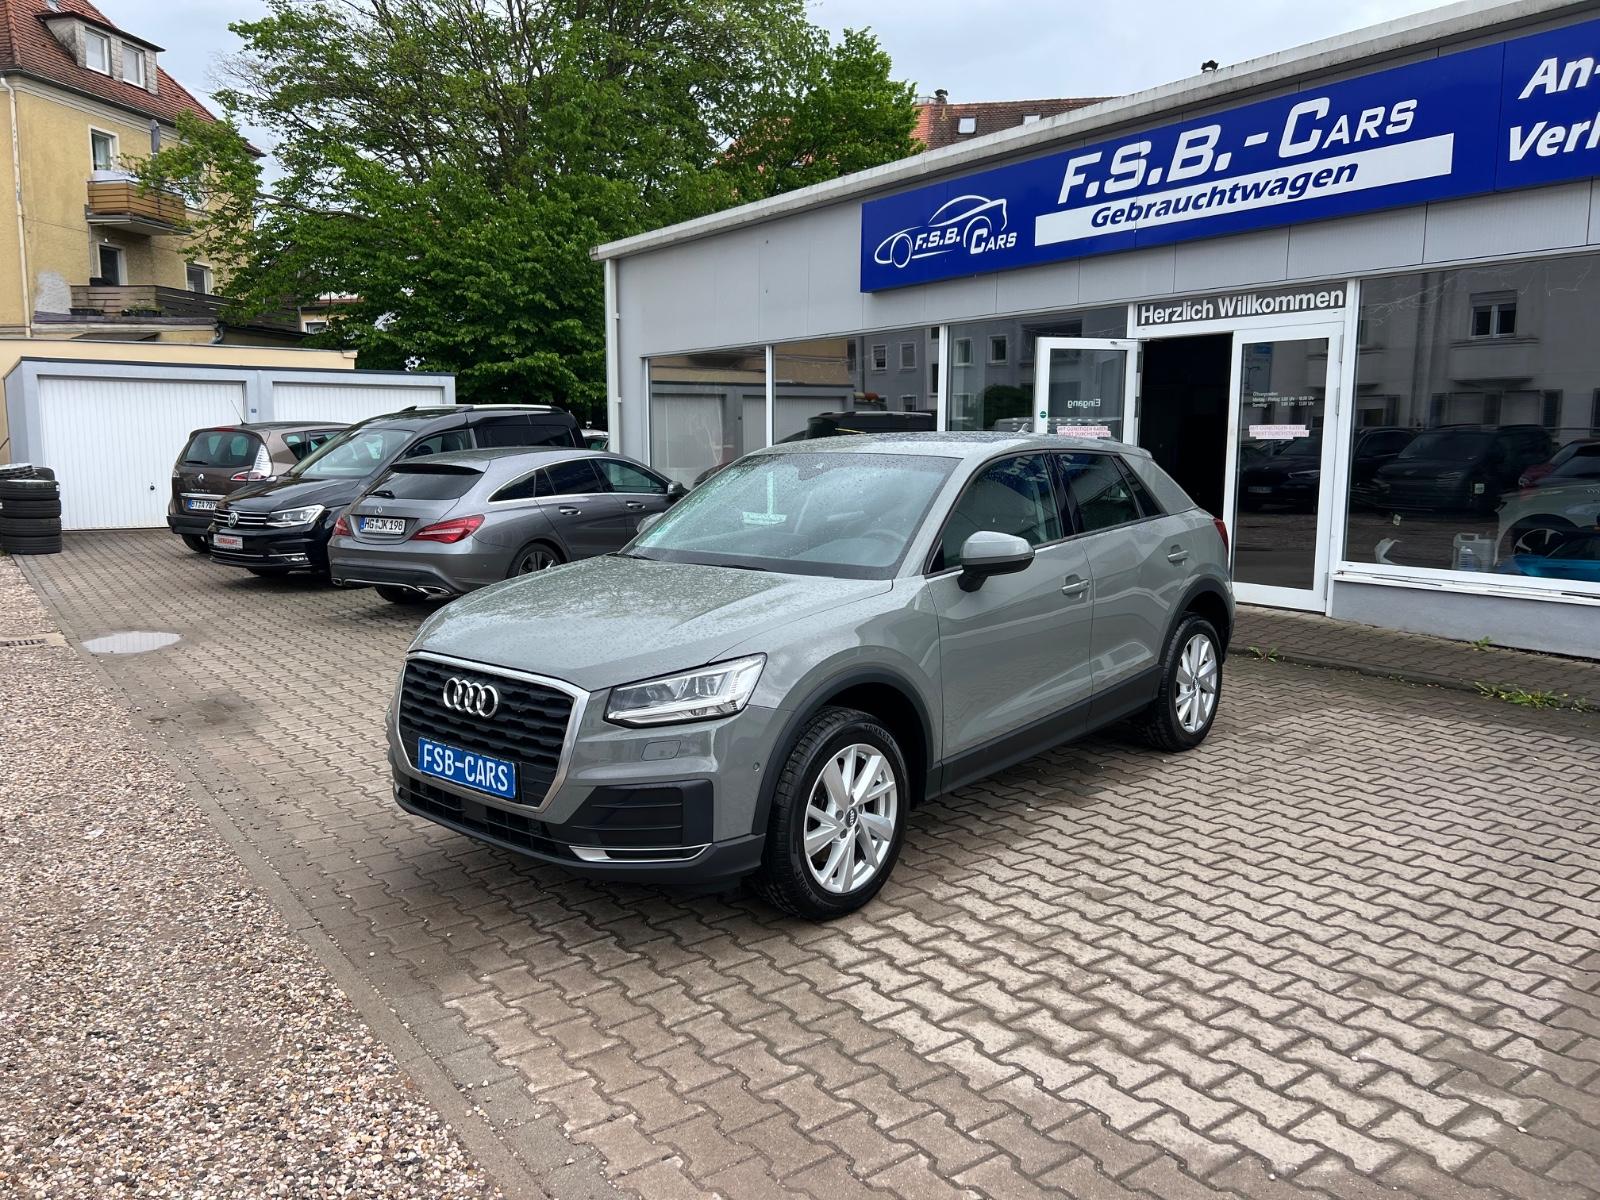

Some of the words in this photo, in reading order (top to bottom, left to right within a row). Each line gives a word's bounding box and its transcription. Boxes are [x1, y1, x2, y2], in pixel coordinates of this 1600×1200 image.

[1091, 161, 1359, 228] Gebrauchtwagen
[914, 227, 960, 251] F.S.B.
[1140, 300, 1214, 325] Herzlich
[1218, 289, 1344, 317] Willkommen
[423, 744, 509, 791] FSB-CARS
